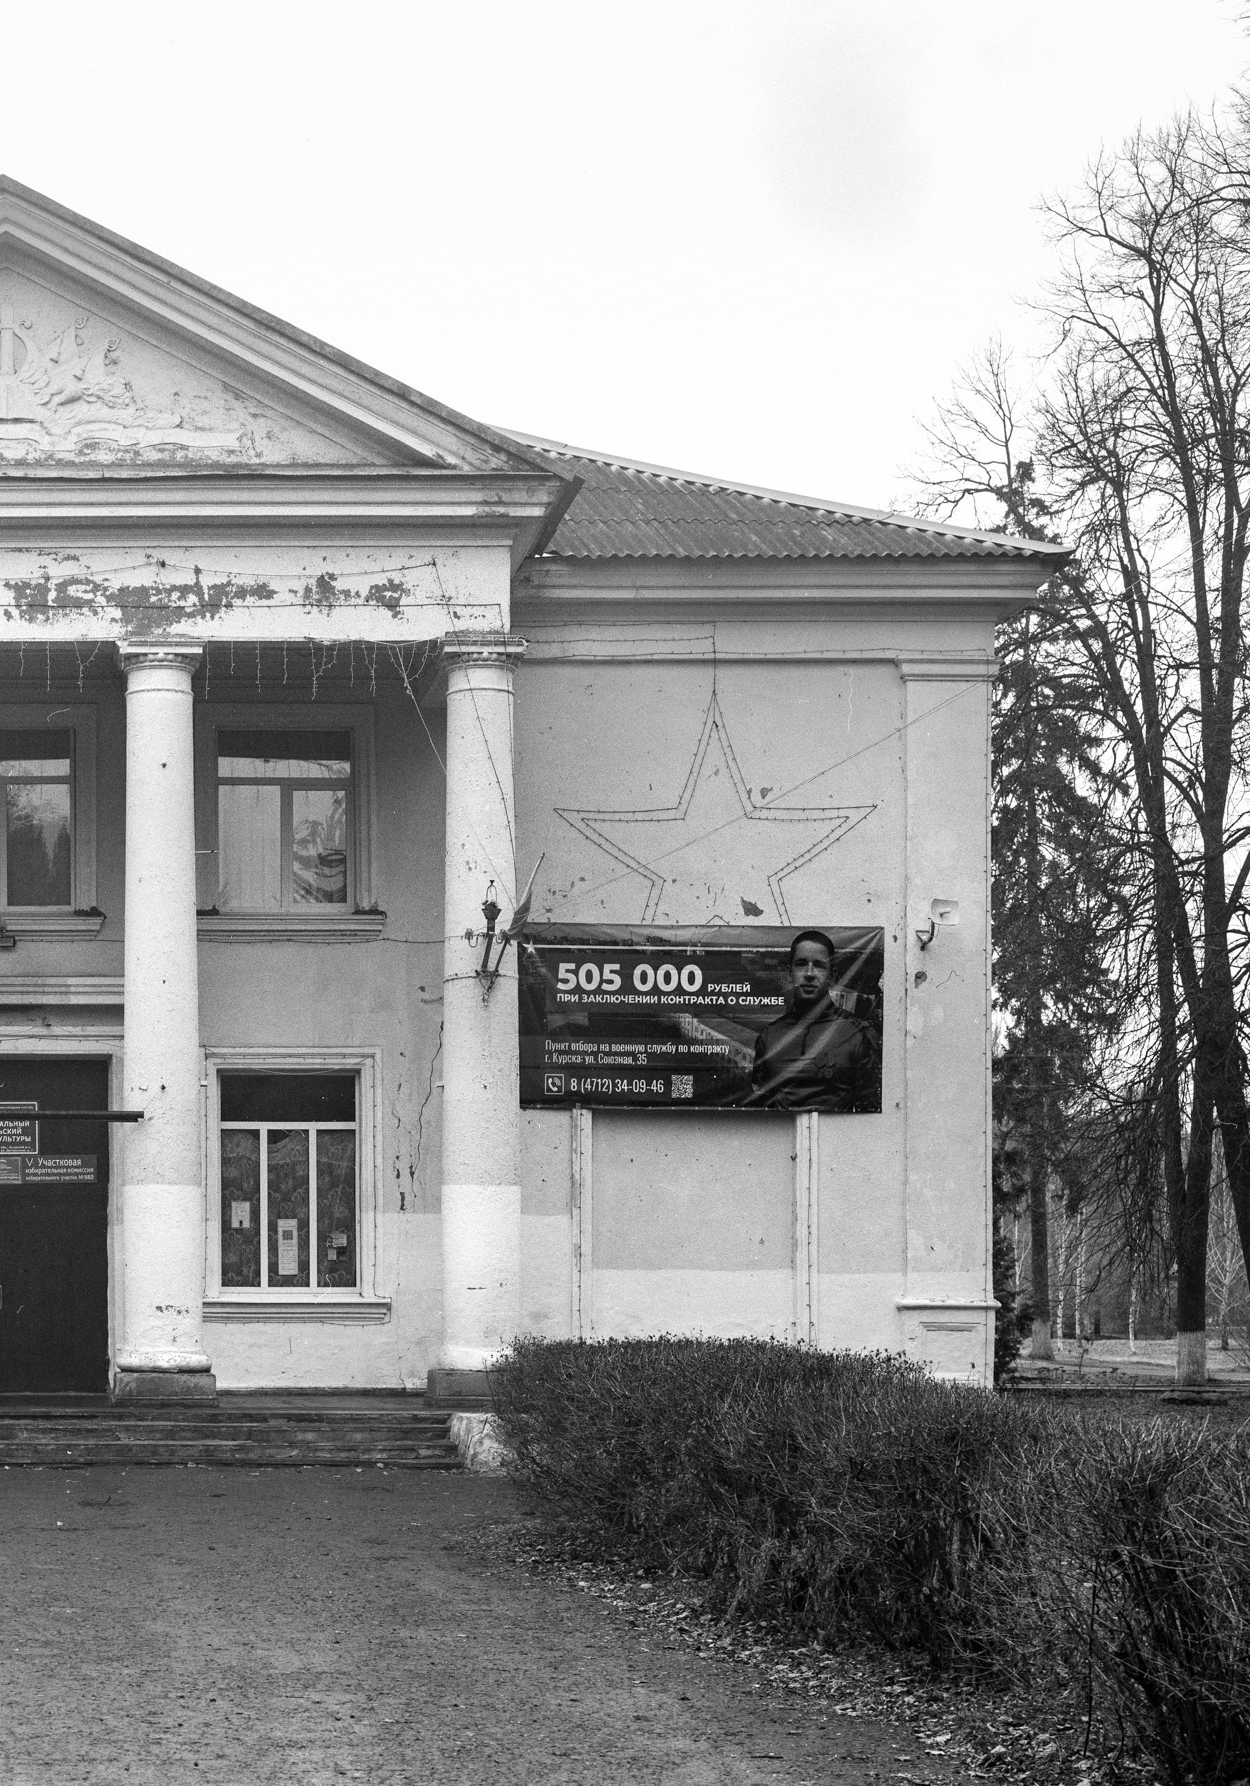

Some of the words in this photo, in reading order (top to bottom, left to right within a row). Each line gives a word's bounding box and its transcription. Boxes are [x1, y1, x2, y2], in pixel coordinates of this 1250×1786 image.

[556, 962, 622, 991] 505
[632, 963, 703, 992] 000
[707, 982, 751, 993] РУБЛЕЙ
[556, 993, 579, 1003] ПРИ
[581, 994, 658, 1004] ЗАКЛЮЧЕНИИ
[660, 995, 725, 1005] КОНТРАКТА
[727, 996, 737, 1005] О
[738, 996, 785, 1005] СЛУЖБЕ
[545, 1040, 569, 1052] Пункт
[571, 1040, 598, 1053] отбора
[599, 1043, 610, 1052] на
[611, 1044, 645, 1054] военную
[647, 1041, 676, 1054] службу
[678, 1044, 688, 1053] по
[690, 1045, 730, 1056] контракту
[545, 1055, 551, 1063] г.
[552, 1052, 584, 1065] Курска:
[585, 1056, 596, 1064] ул.
[598, 1053, 635, 1065] Союзная,
[636, 1054, 647, 1065] 35
[570, 1078, 578, 1091] 8
[581, 1078, 613, 1094] (4712)
[615, 1079, 664, 1093] 34-09-46
[37, 1157, 82, 1167] Участковая
[25, 1167, 67, 1175] избирательная
